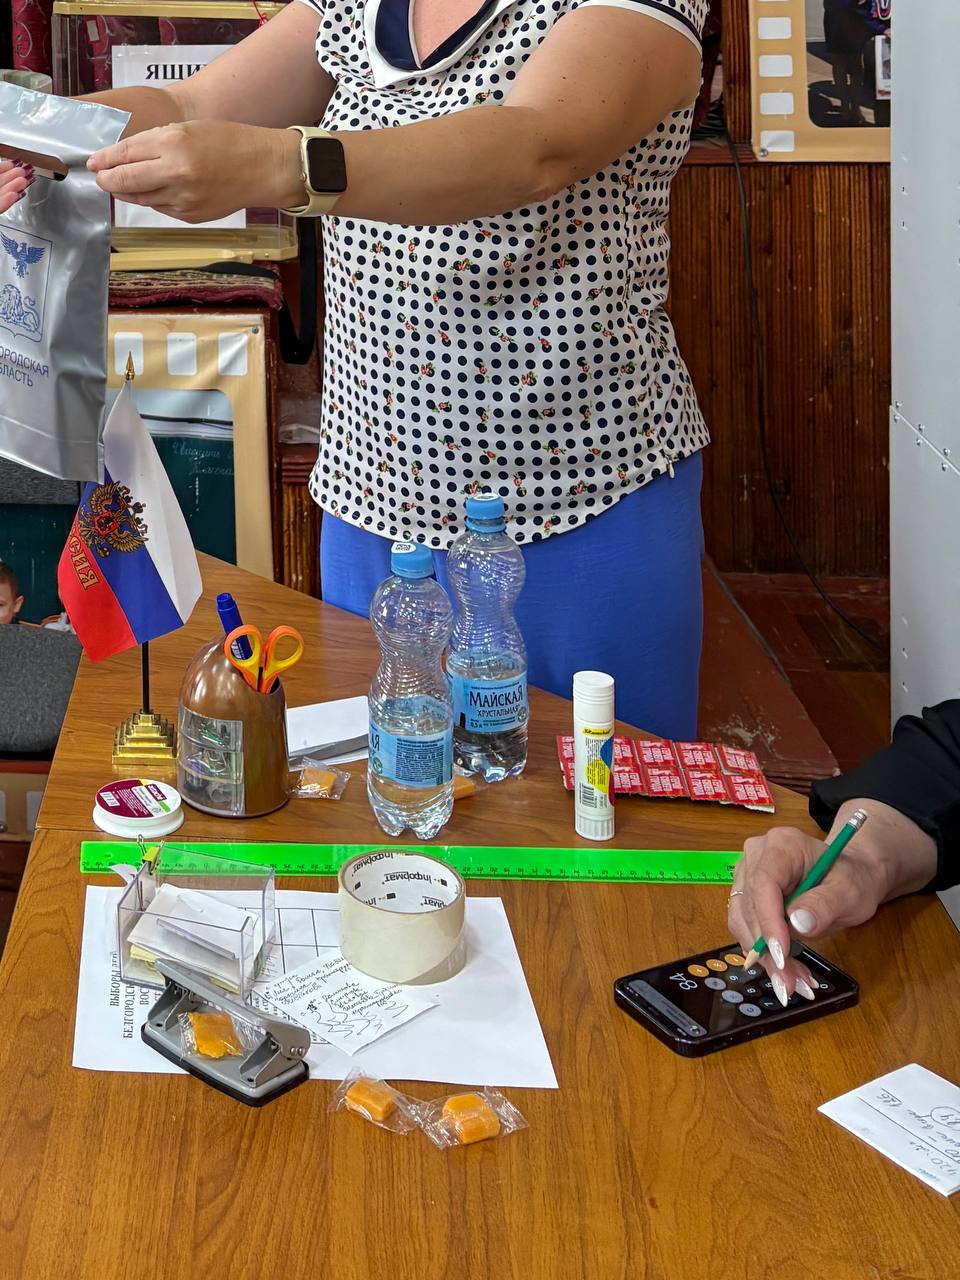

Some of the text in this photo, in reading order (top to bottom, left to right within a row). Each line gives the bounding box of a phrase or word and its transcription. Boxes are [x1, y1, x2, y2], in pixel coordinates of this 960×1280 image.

[145, 63, 208, 81] ЯЩИ
[68, 531, 101, 591] СИЯ
[469, 685, 523, 708] МАЙСКАЯ
[109, 969, 121, 1007] ВЫБОРЫ
[668, 971, 699, 991] 84
[139, 987, 150, 1006] ВОС
[123, 984, 136, 1039] БЕЛГОРОДСК
